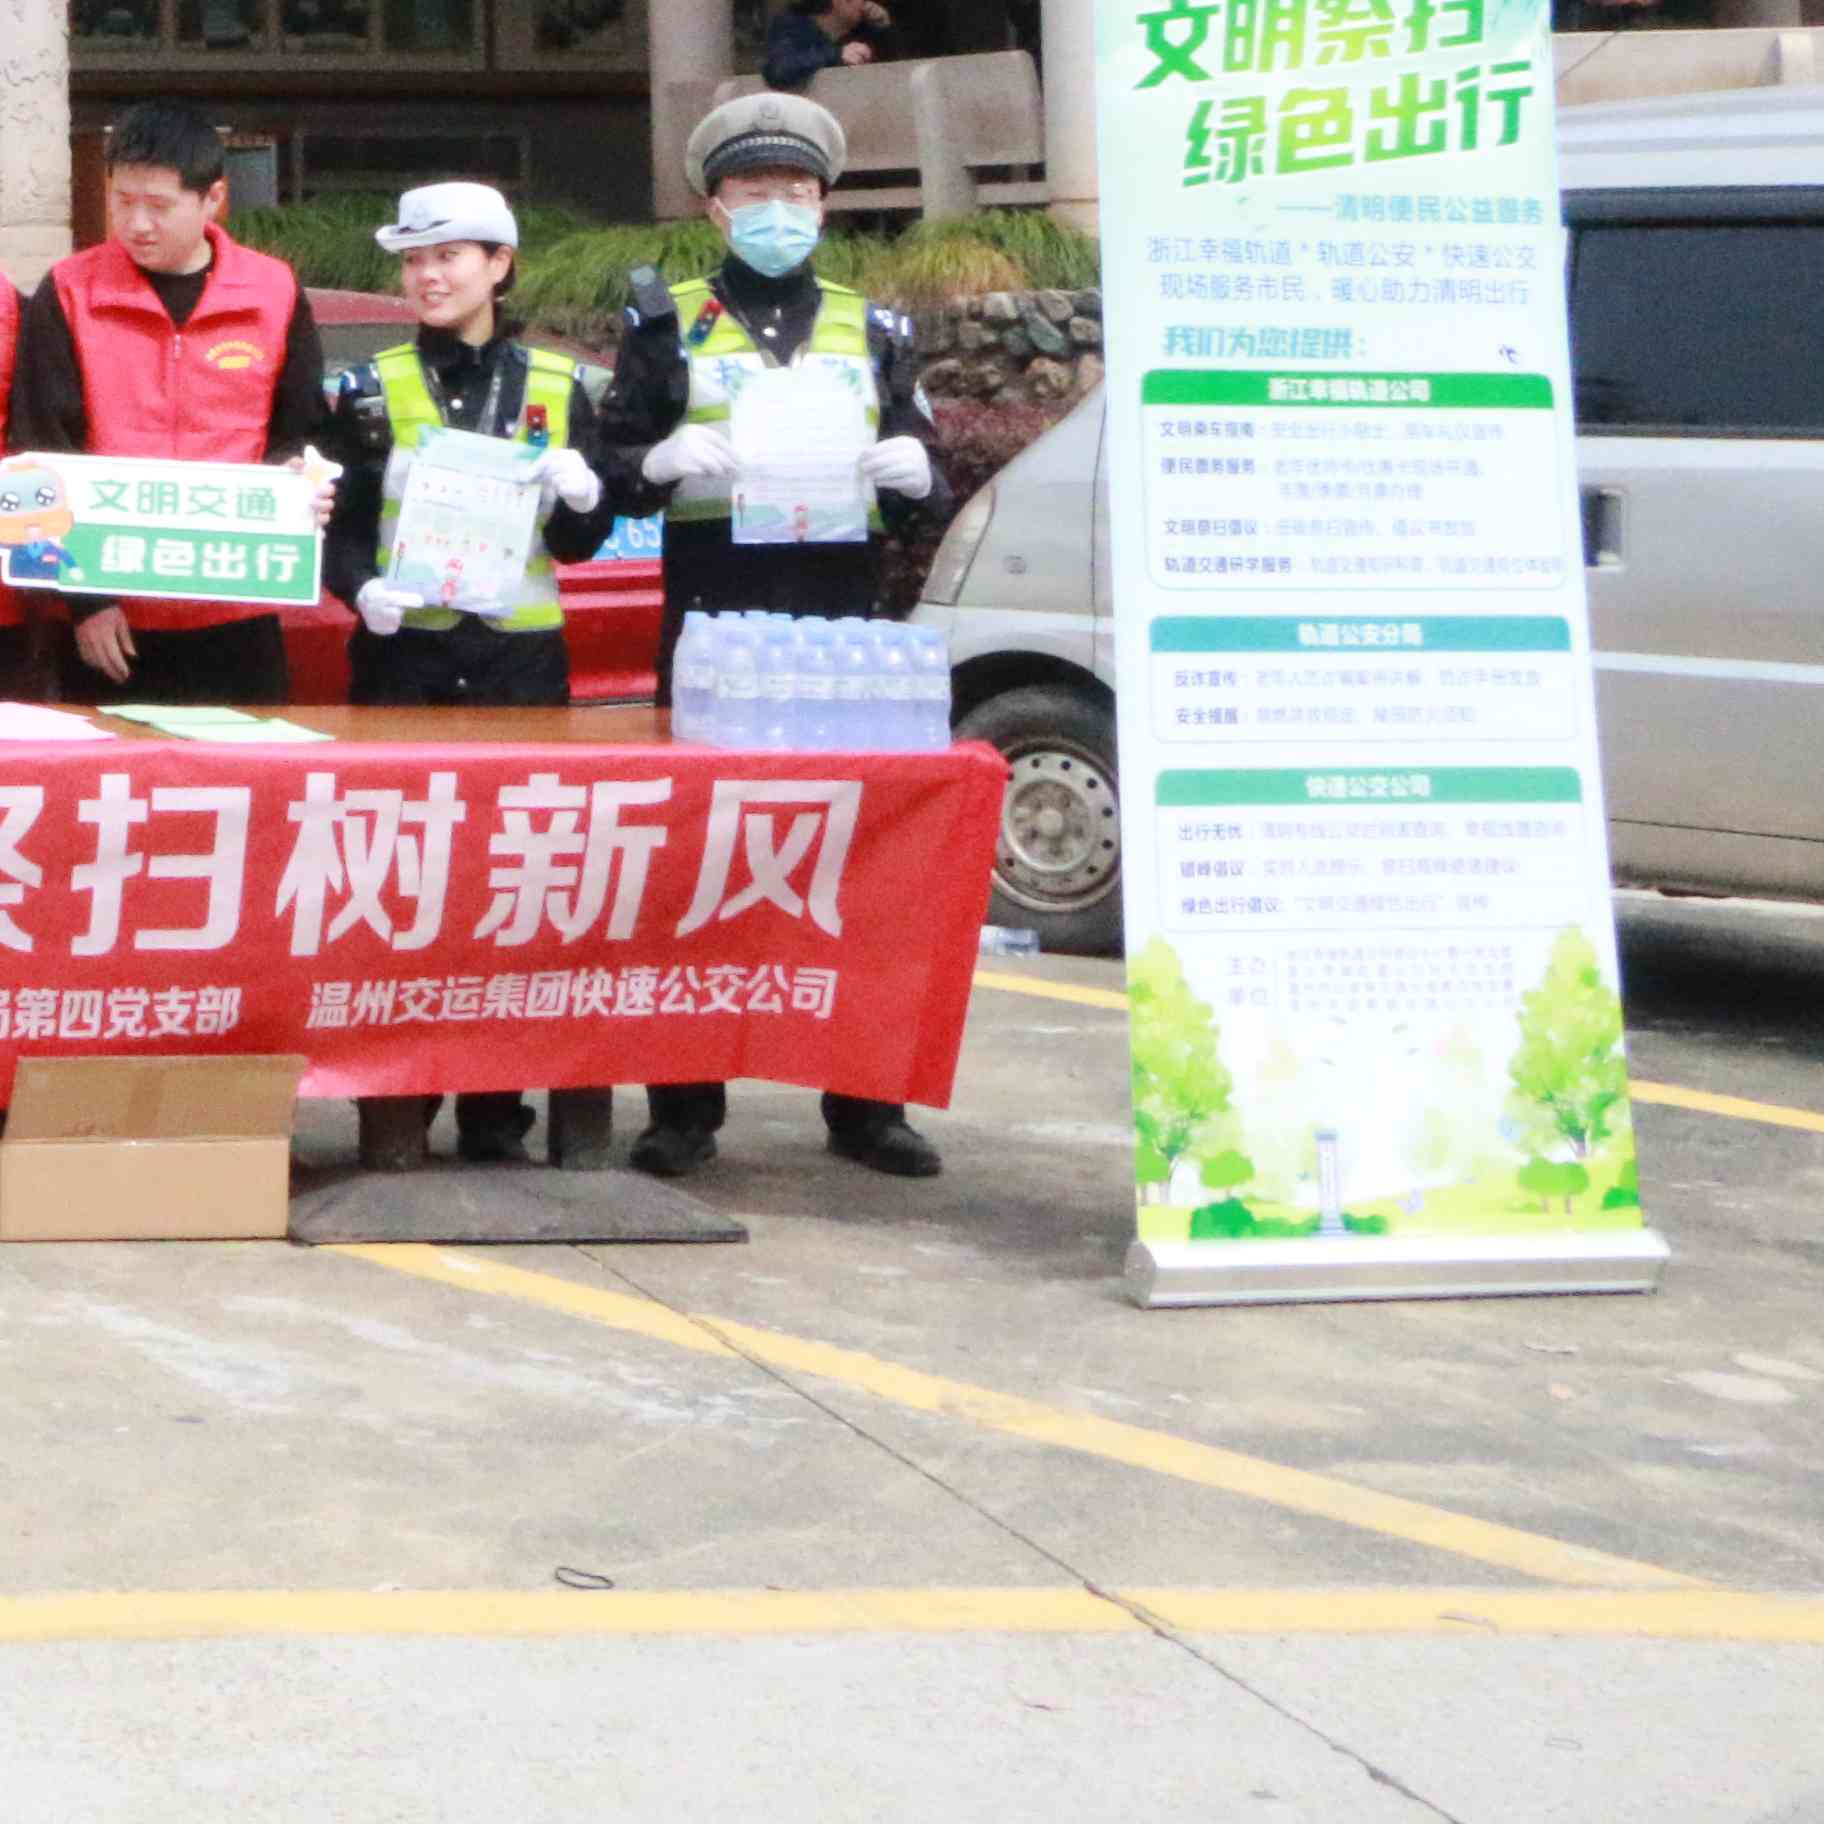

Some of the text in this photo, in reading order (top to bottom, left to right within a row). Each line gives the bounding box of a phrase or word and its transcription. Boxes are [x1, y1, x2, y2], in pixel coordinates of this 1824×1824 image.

[1182, 59, 1534, 187] 绿色出行
[89, 479, 276, 522] 文明交通
[100, 534, 301, 583] 绿色出行
[307, 964, 839, 1028] 温州交运集团快速公交公司
